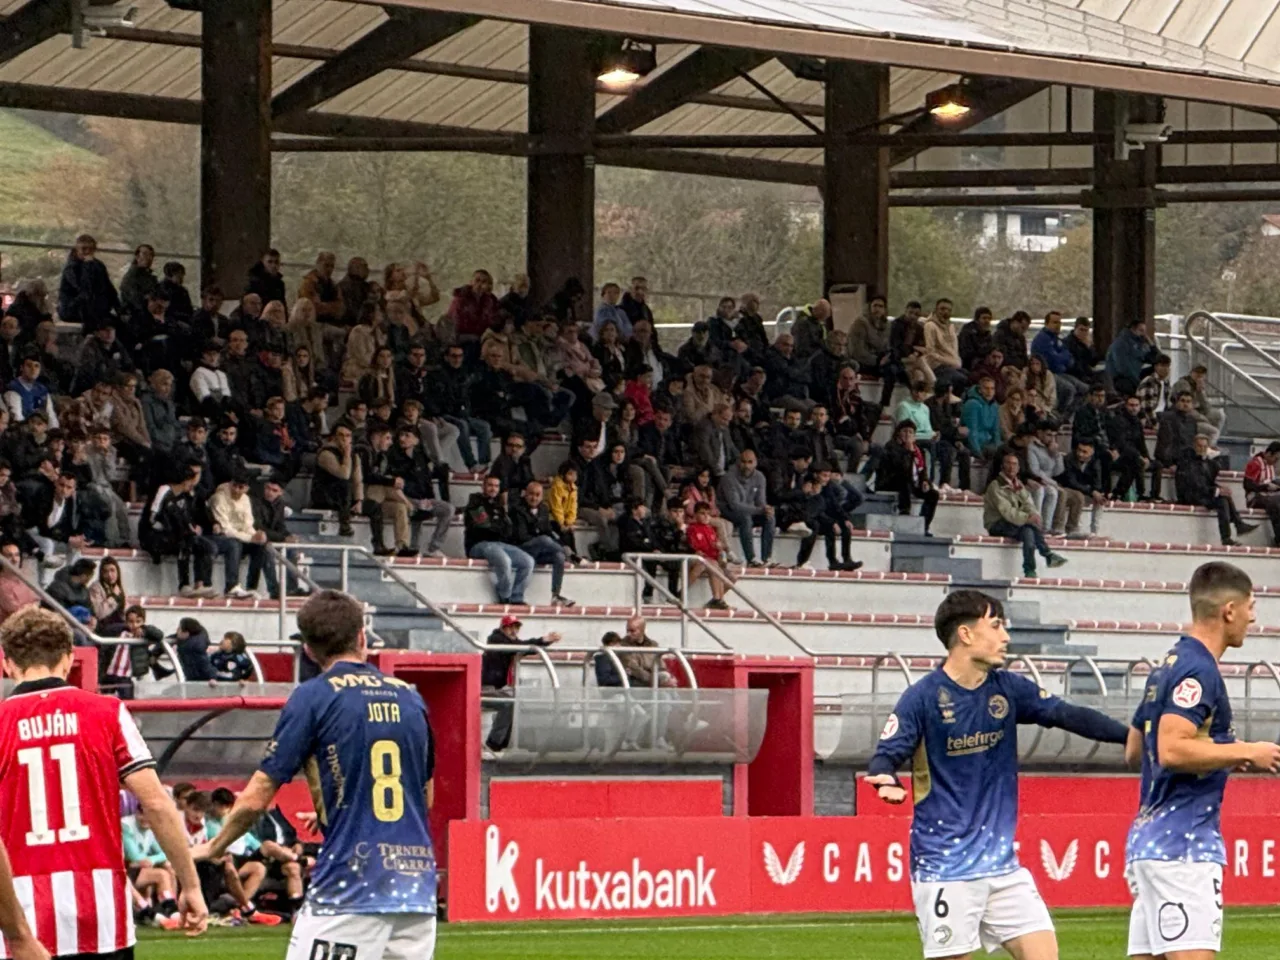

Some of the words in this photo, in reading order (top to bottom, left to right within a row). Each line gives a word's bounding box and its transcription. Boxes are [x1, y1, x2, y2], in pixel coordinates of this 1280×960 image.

[17, 709, 78, 742] BUJÁN
[367, 702, 401, 723] JOTA
[17, 743, 90, 847] 11
[370, 740, 404, 822] 8
[535, 855, 717, 911] kutxabank
[933, 887, 949, 919] 6
